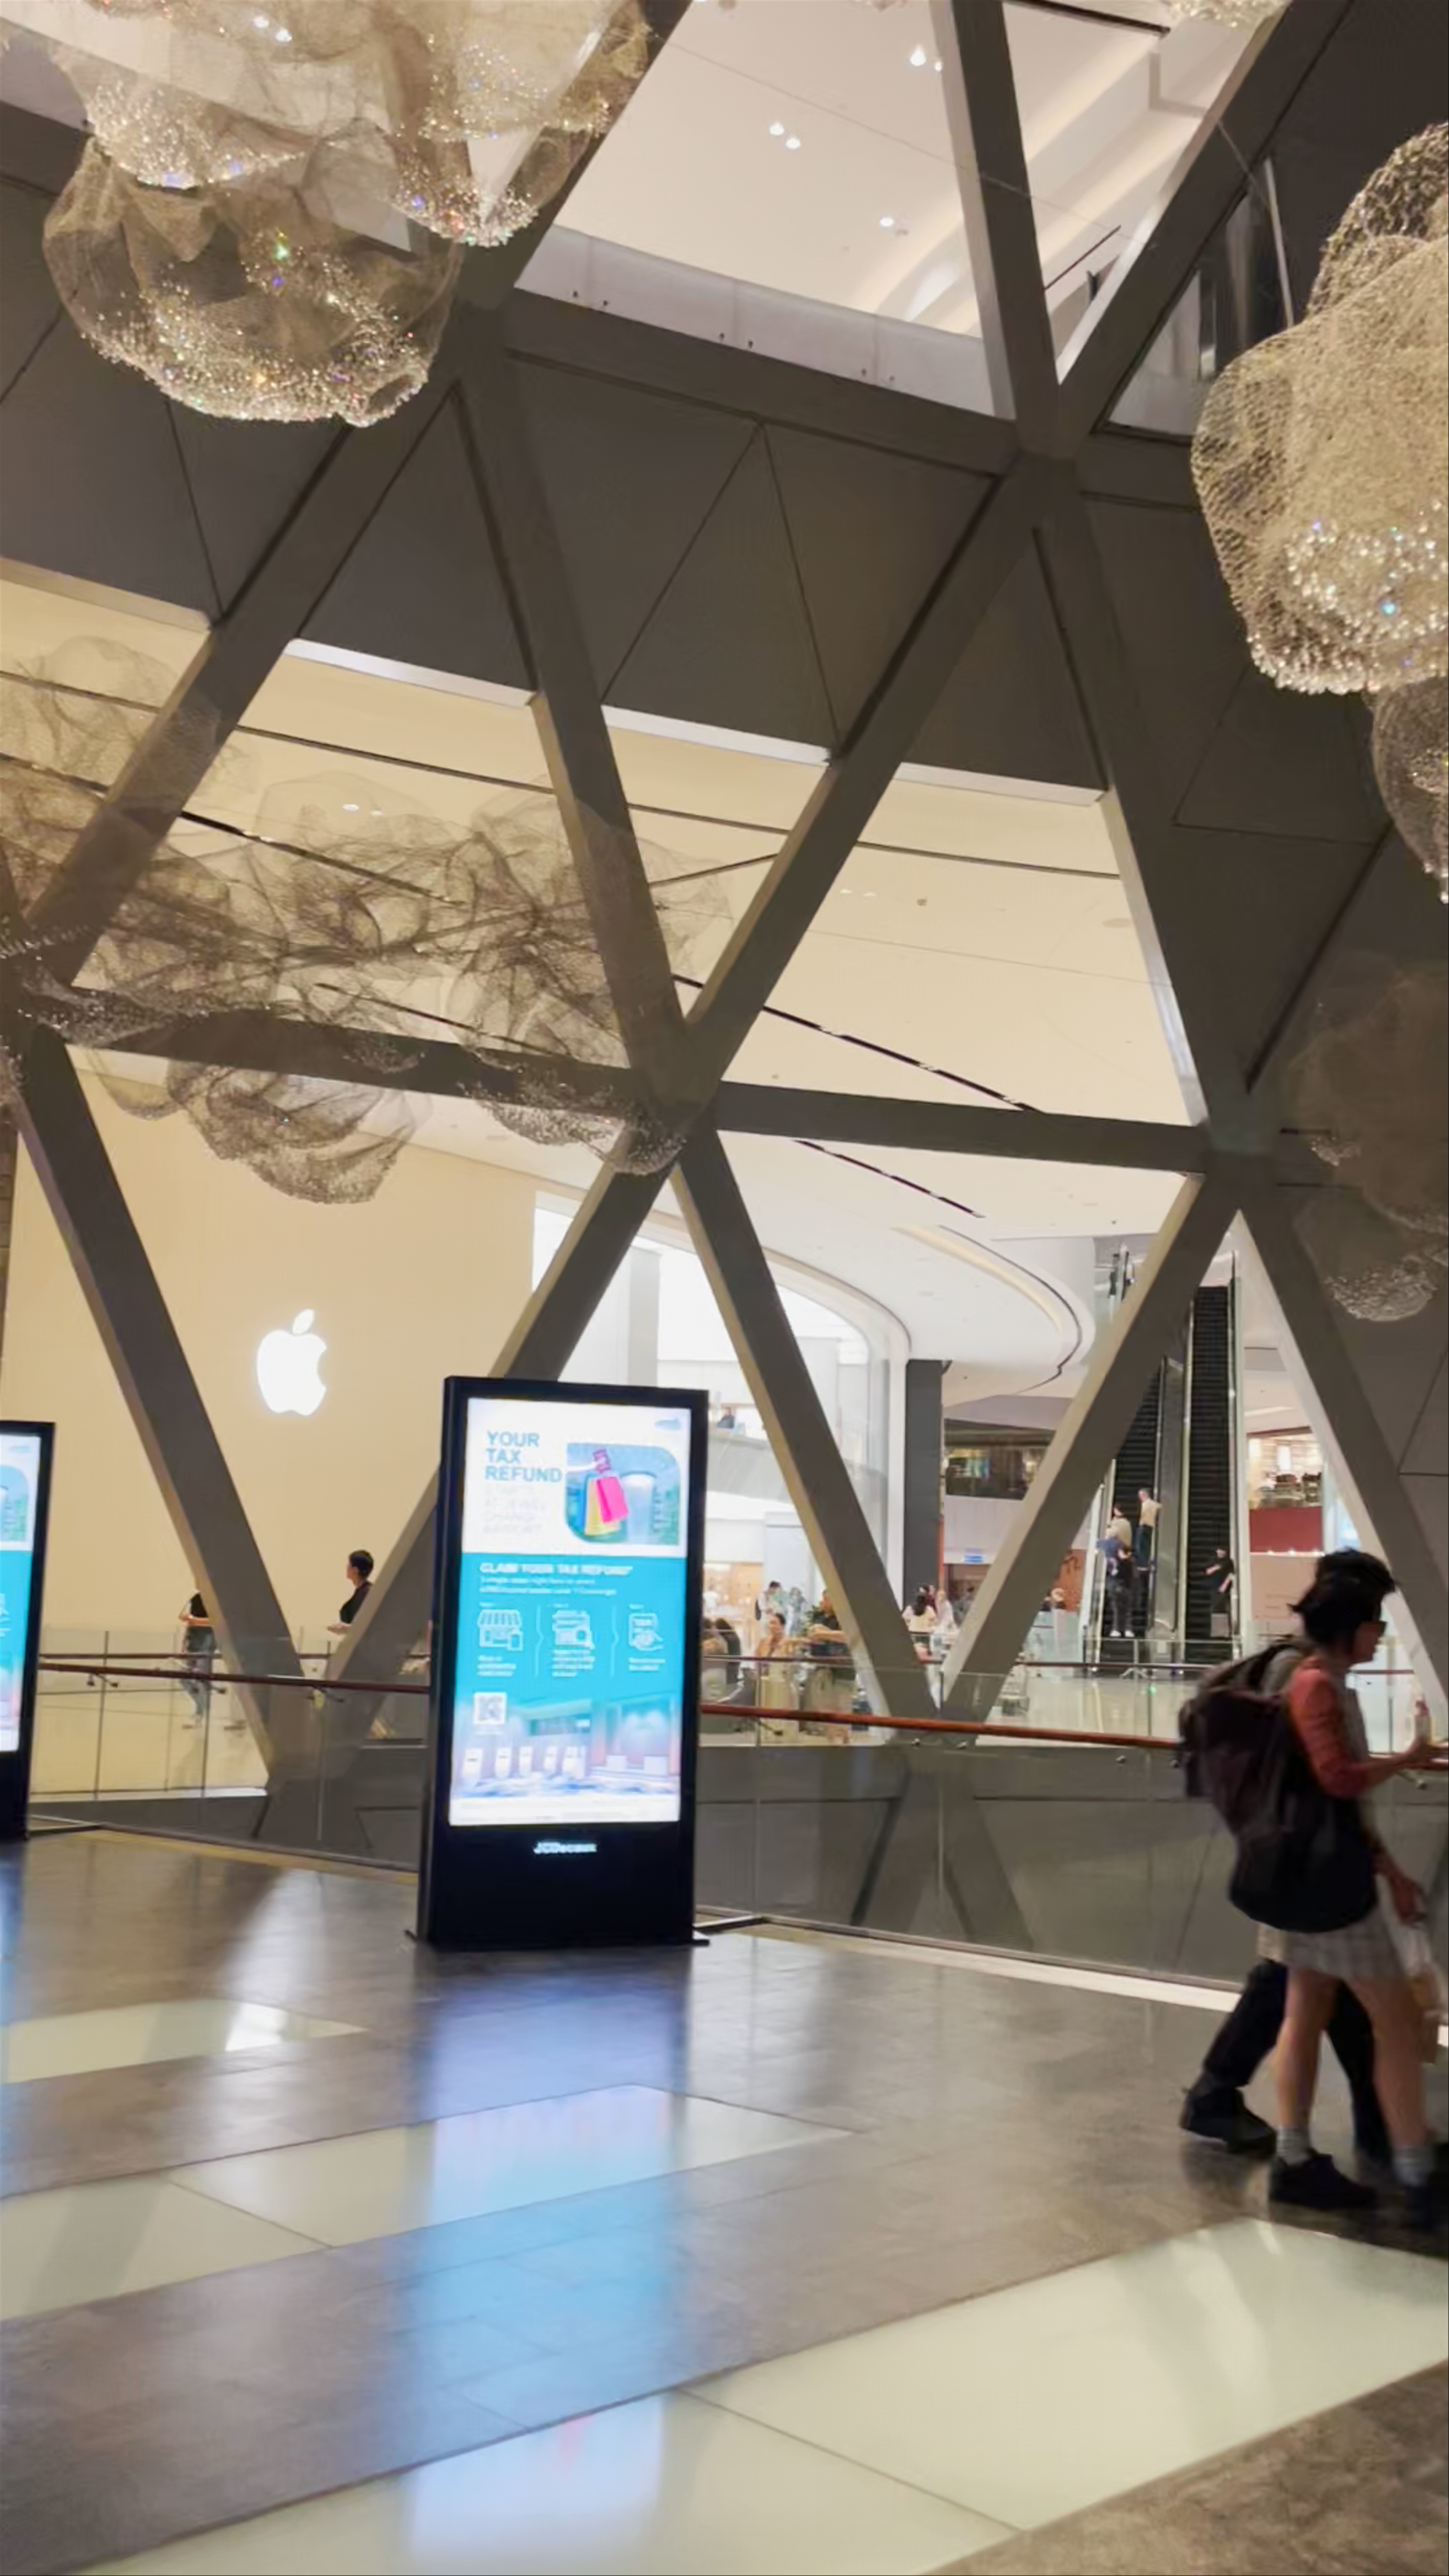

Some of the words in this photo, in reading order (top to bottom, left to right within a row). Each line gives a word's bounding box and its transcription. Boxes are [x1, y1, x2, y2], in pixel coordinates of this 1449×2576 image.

[487, 1431, 539, 1448] YOUR
[486, 1448, 521, 1463] TAX
[485, 1466, 562, 1482] REFUND
